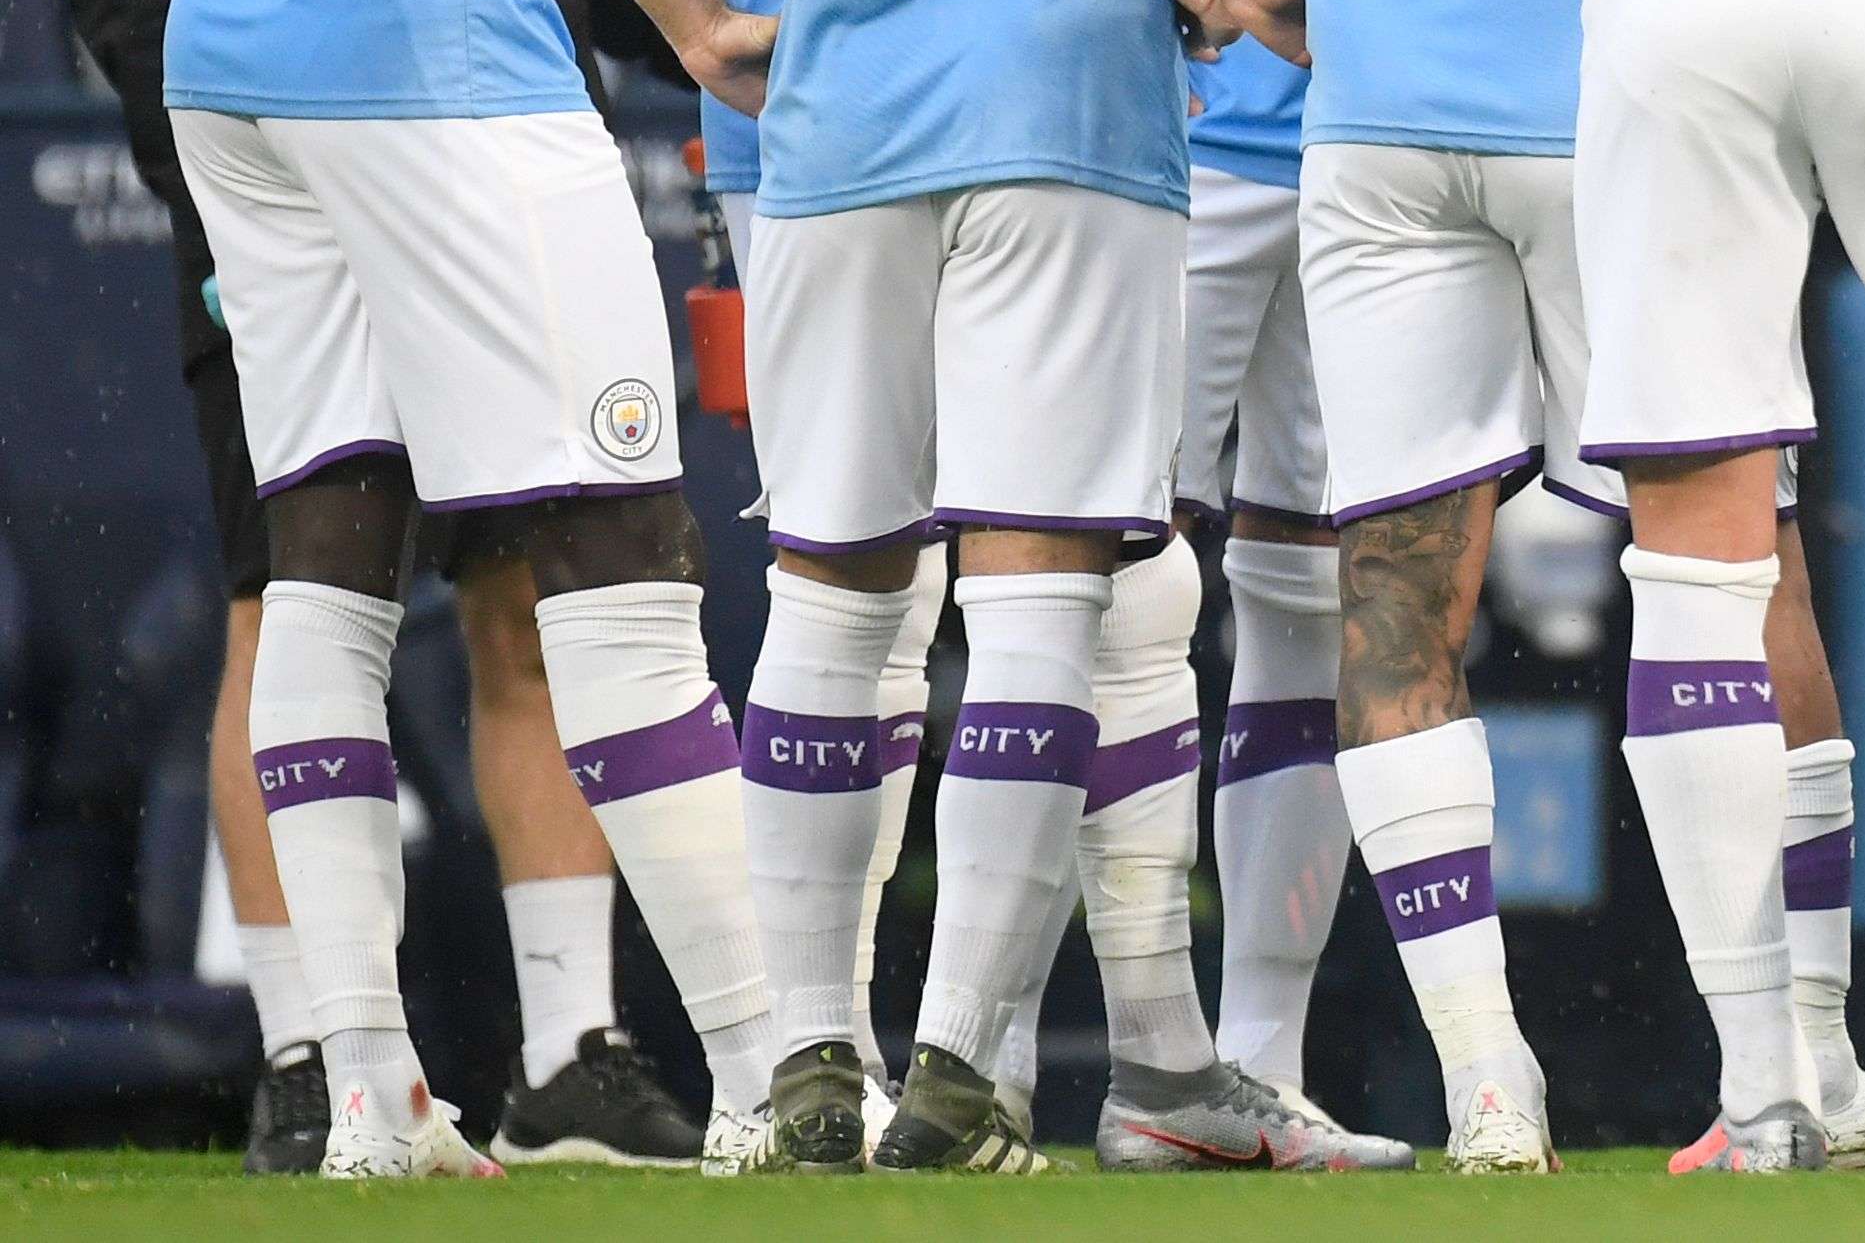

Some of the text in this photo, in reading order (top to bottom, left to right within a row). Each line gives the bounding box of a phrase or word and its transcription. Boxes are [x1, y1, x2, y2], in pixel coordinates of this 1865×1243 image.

[1672, 681, 1773, 708] CITY
[769, 734, 866, 768] CITY
[959, 726, 1055, 755] CITY
[260, 756, 347, 792] CITY
[1394, 875, 1472, 917] CITY
